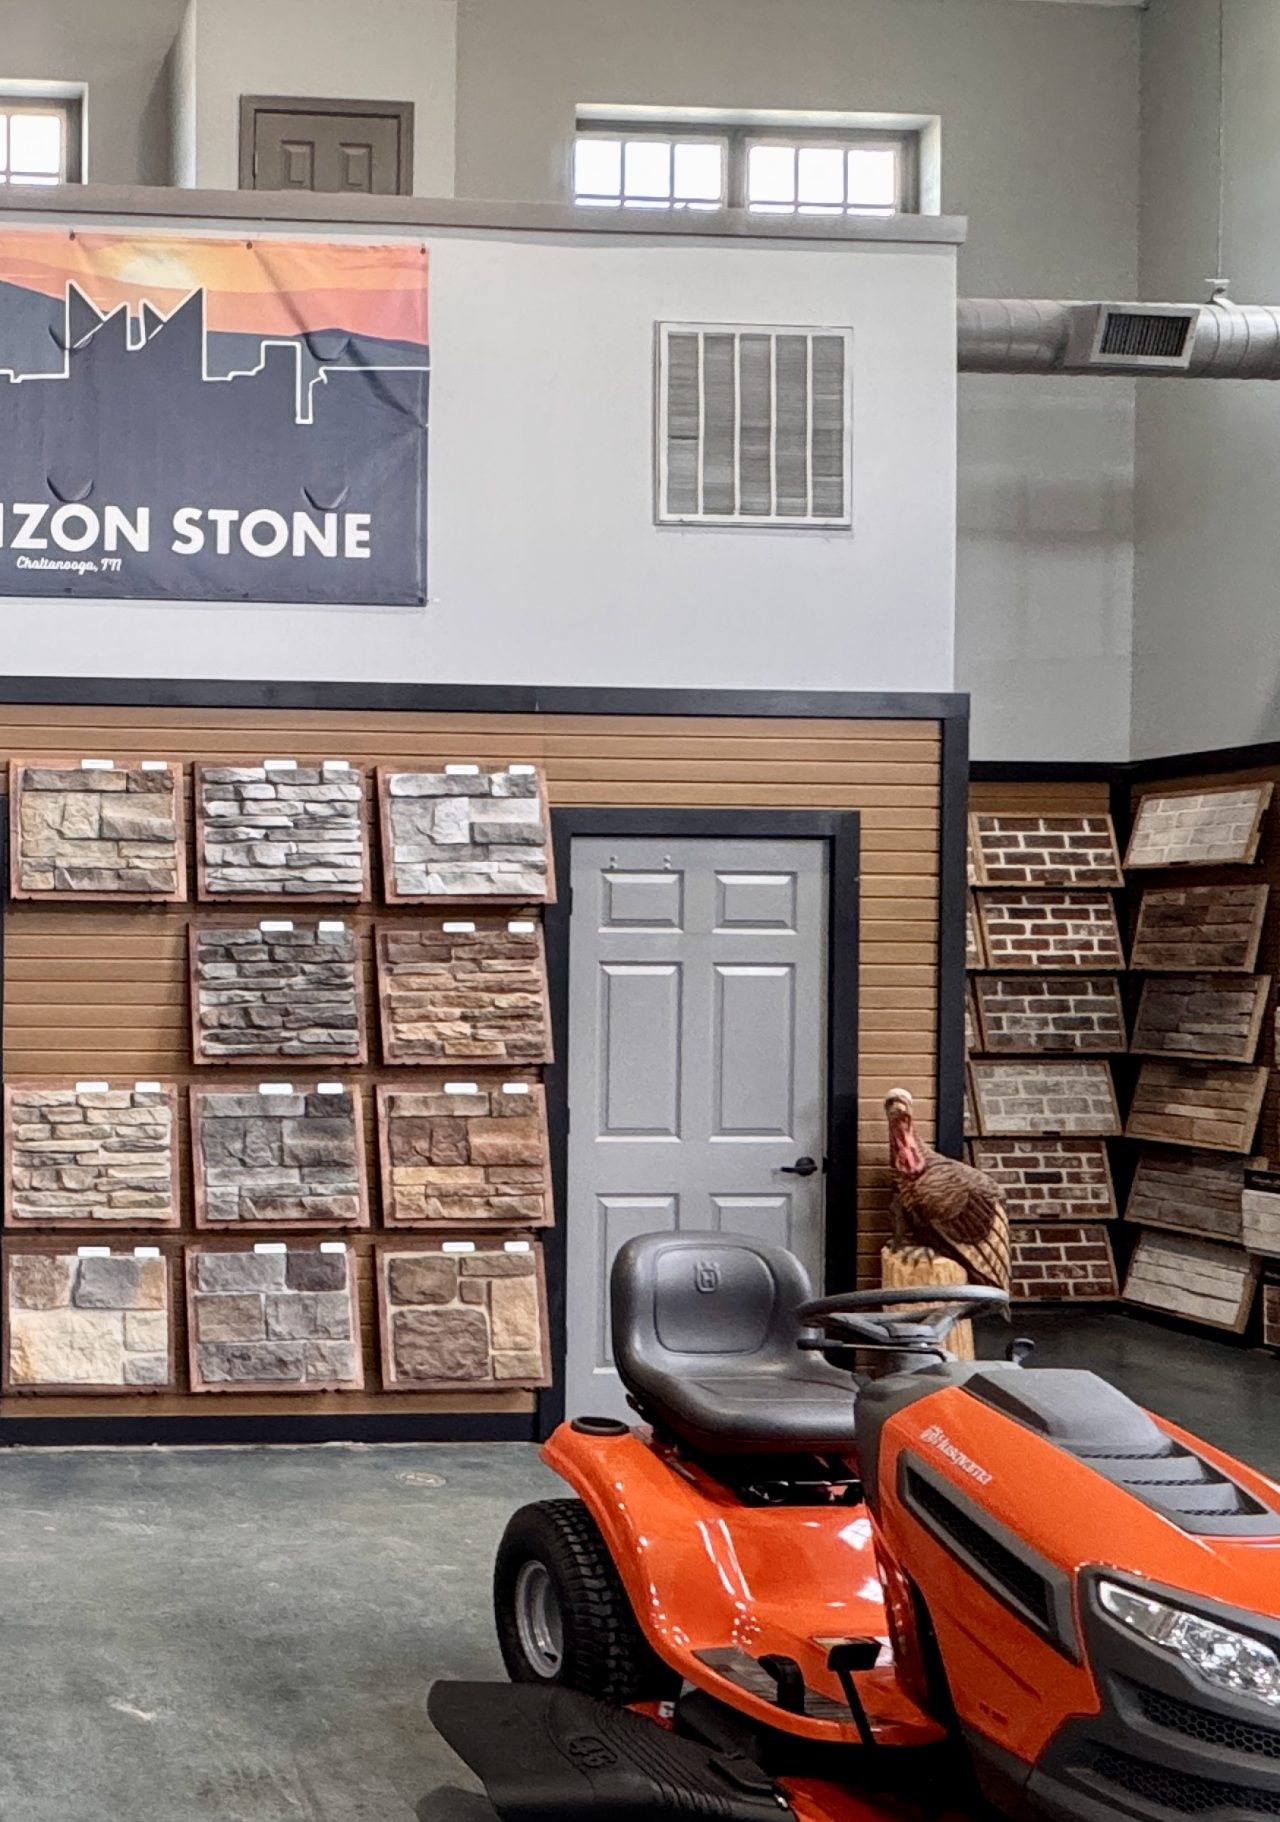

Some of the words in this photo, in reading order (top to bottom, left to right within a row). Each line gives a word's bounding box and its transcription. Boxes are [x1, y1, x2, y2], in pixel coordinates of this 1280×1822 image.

[171, 507, 371, 558] STONE
[16, 555, 98, 575] Chattanooga,
[100, 558, 122, 571] TN
